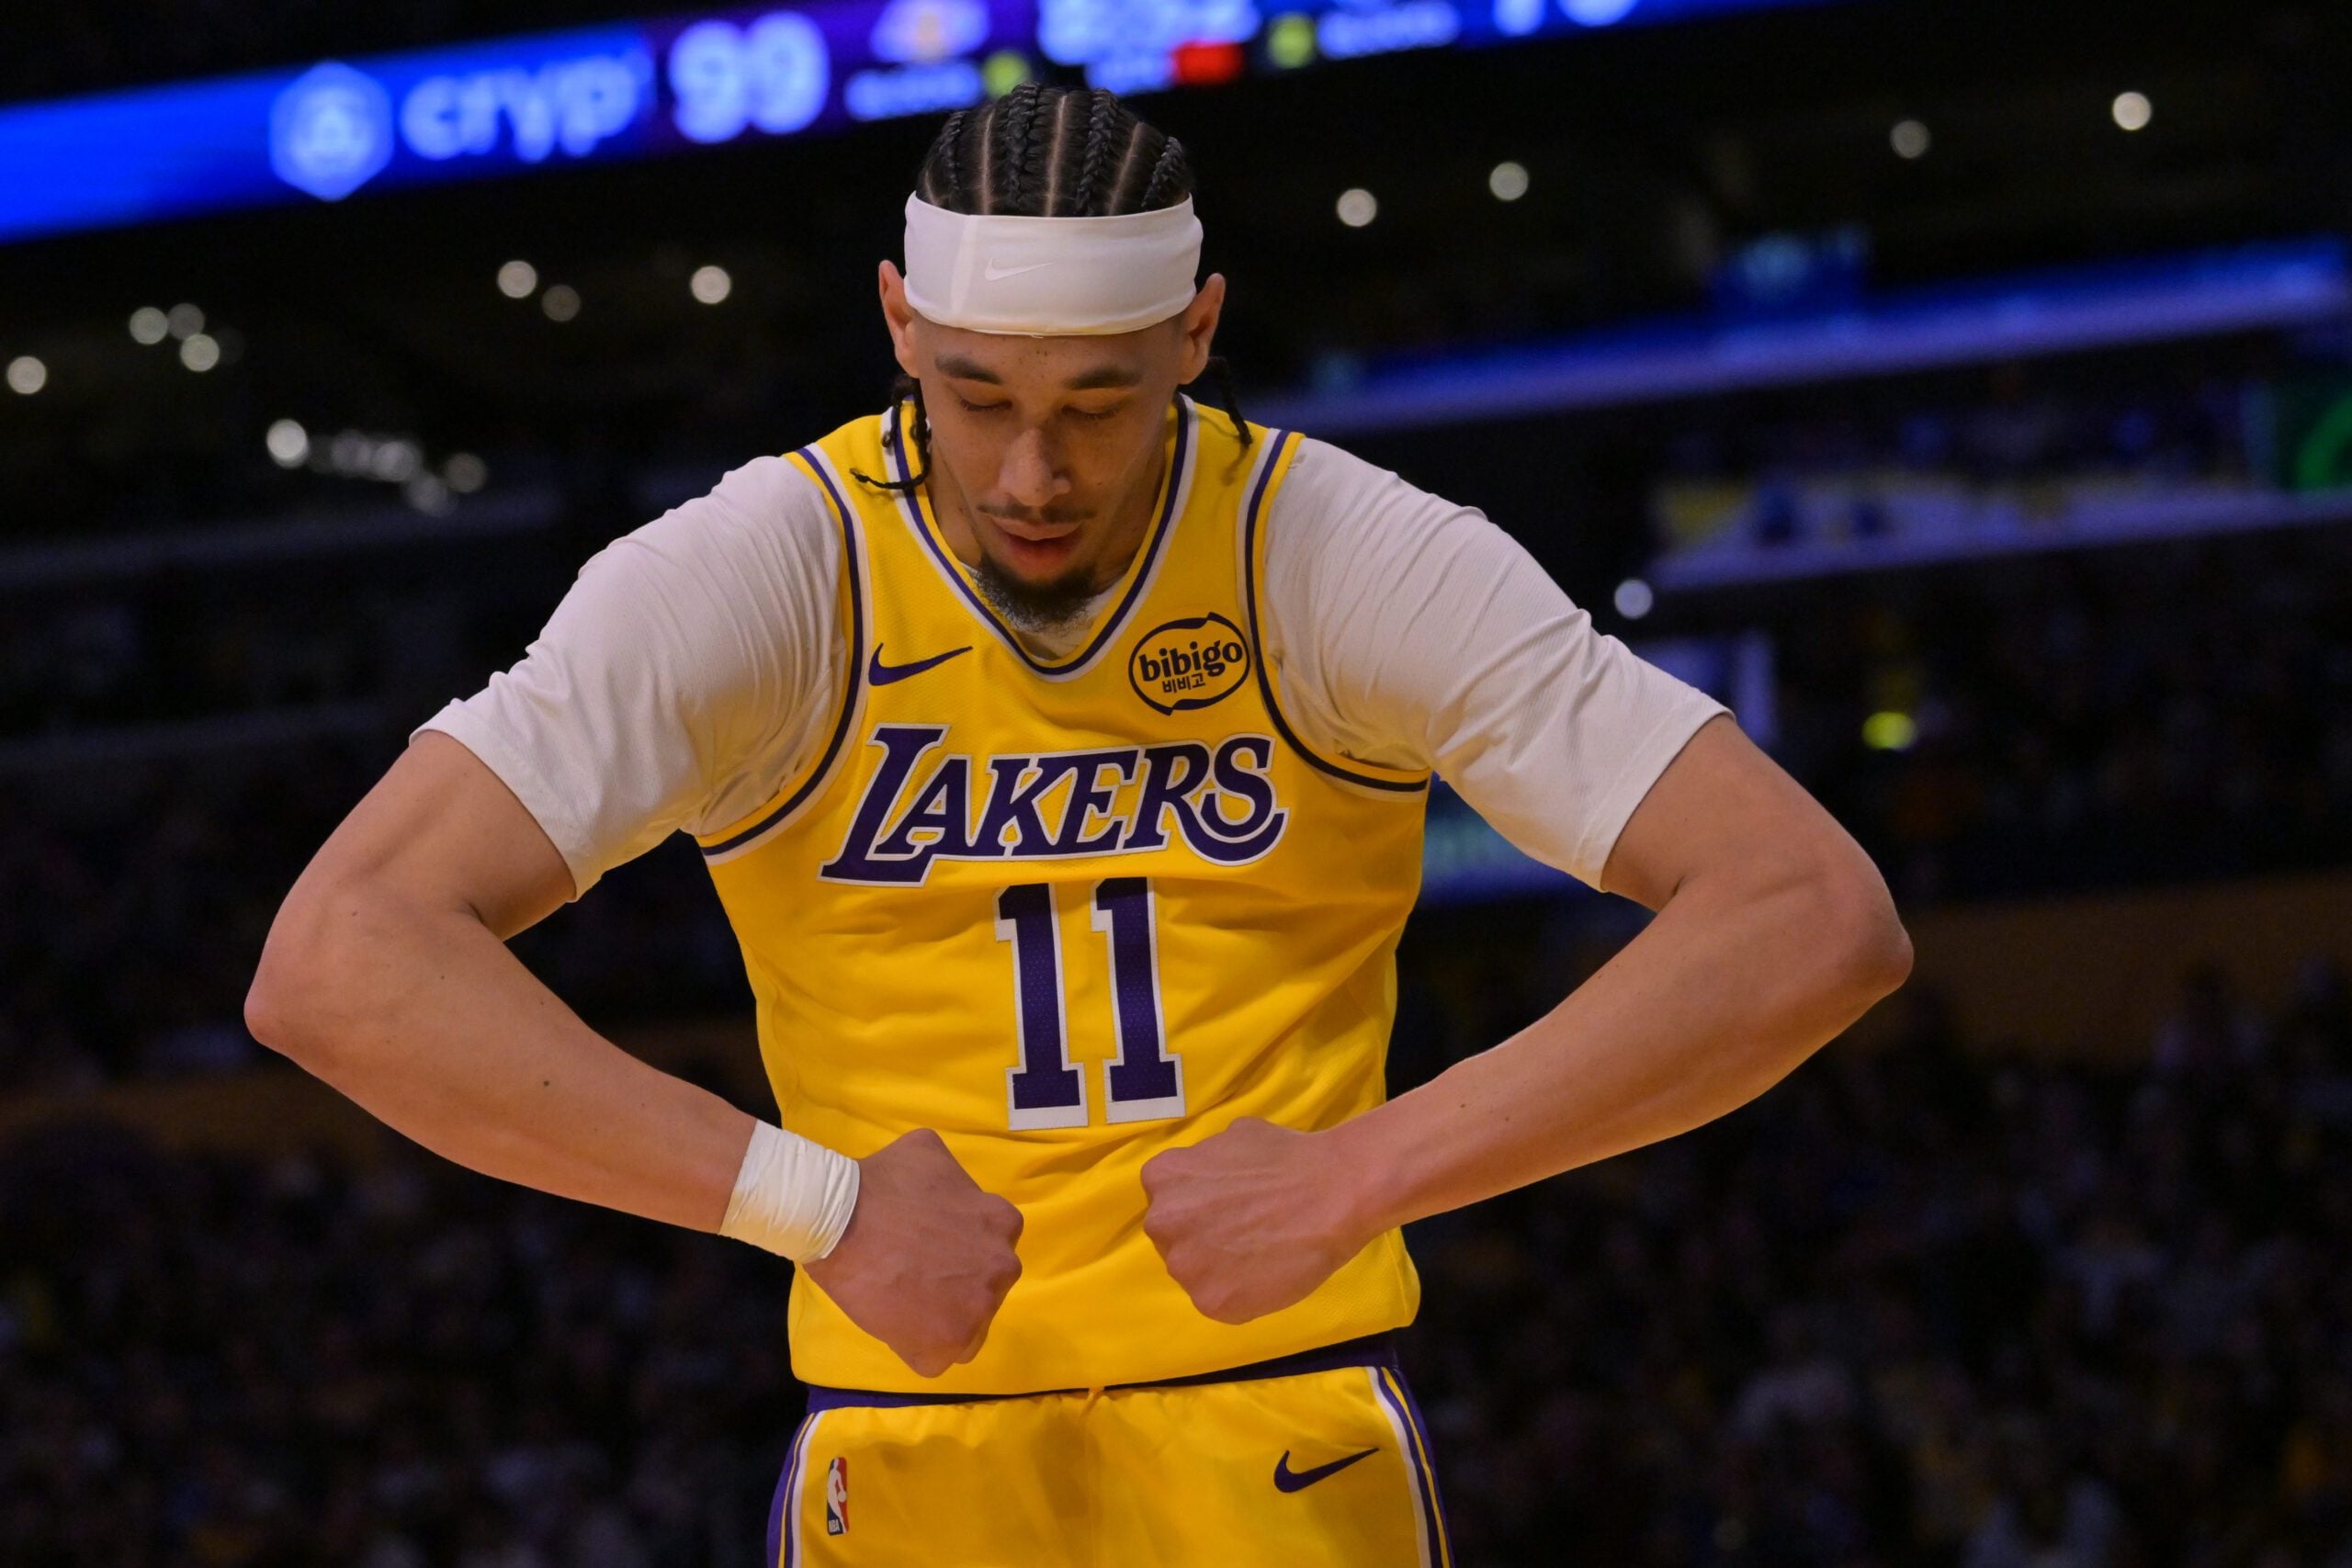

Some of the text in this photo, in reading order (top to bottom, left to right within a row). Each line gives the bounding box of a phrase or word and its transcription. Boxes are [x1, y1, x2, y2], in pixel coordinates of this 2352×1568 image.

[669, 11, 828, 144] 99
[1138, 640, 1243, 682] bibigo
[1162, 672, 1206, 694] 비비고
[817, 723, 1290, 887] LAKERS
[993, 876, 1186, 1132] 11
